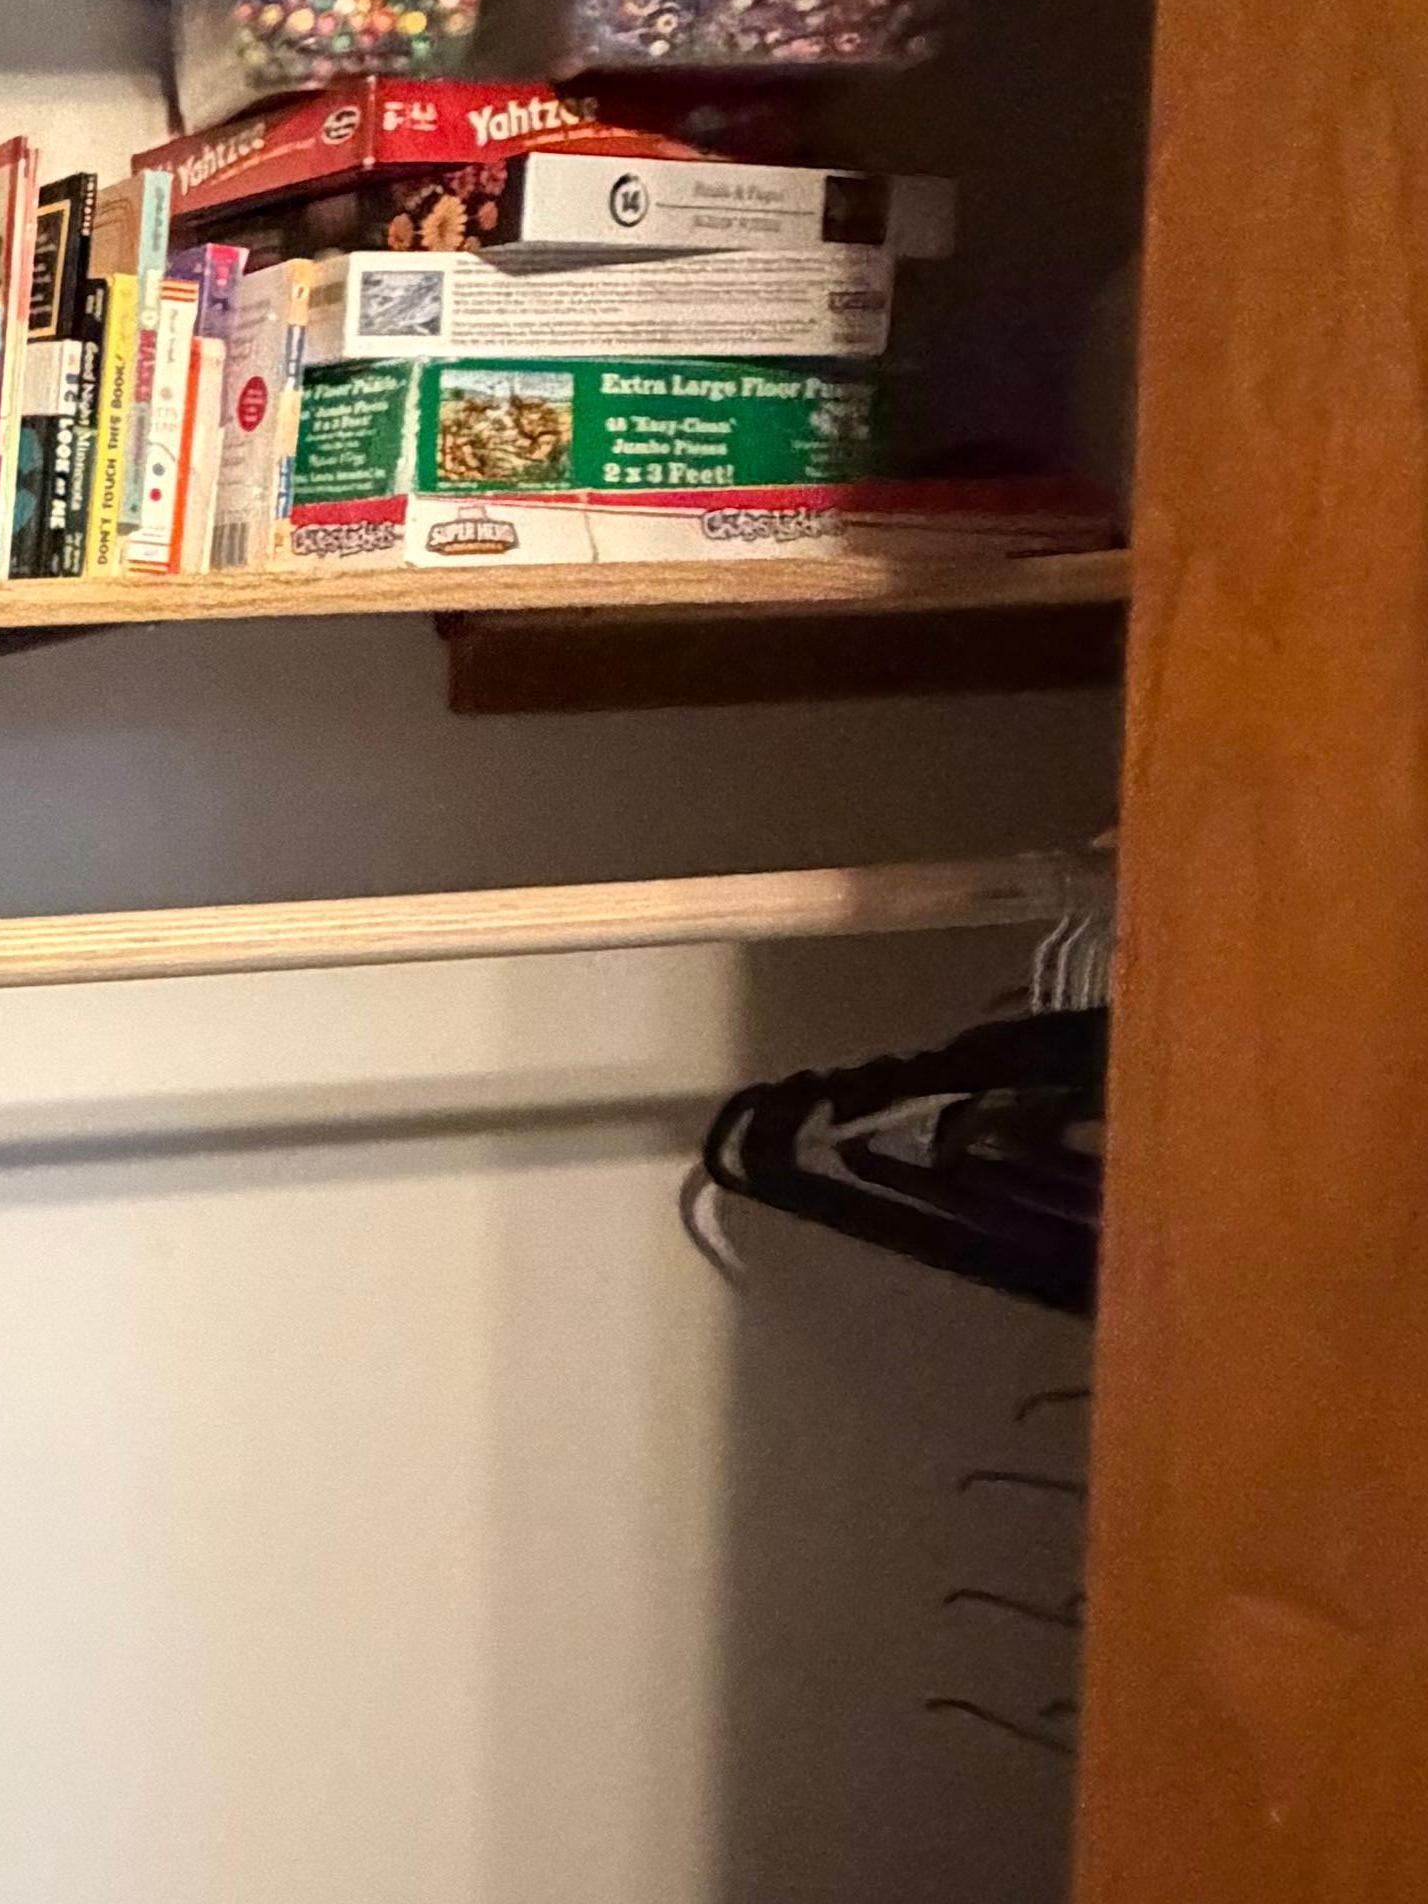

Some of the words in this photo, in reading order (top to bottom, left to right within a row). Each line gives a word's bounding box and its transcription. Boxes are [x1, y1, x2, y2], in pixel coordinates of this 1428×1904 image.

[84, 341, 99, 381] Good
[110, 354, 128, 409] BOOK!
[600, 372, 671, 398] Extra
[672, 374, 739, 401] Large
[740, 376, 801, 400] Floor
[54, 417, 75, 474] LOOK
[107, 414, 123, 452] THIS
[610, 439, 669, 457] Jumbo
[673, 440, 728, 457] Pieces
[70, 426, 91, 512] Minnesota
[101, 457, 118, 510] TOUCH
[603, 463, 622, 484] 2
[627, 467, 641, 484] x
[645, 463, 662, 485] 3
[666, 462, 735, 486] Feet!
[49, 499, 67, 529] ME
[97, 518, 114, 566] DON'T
